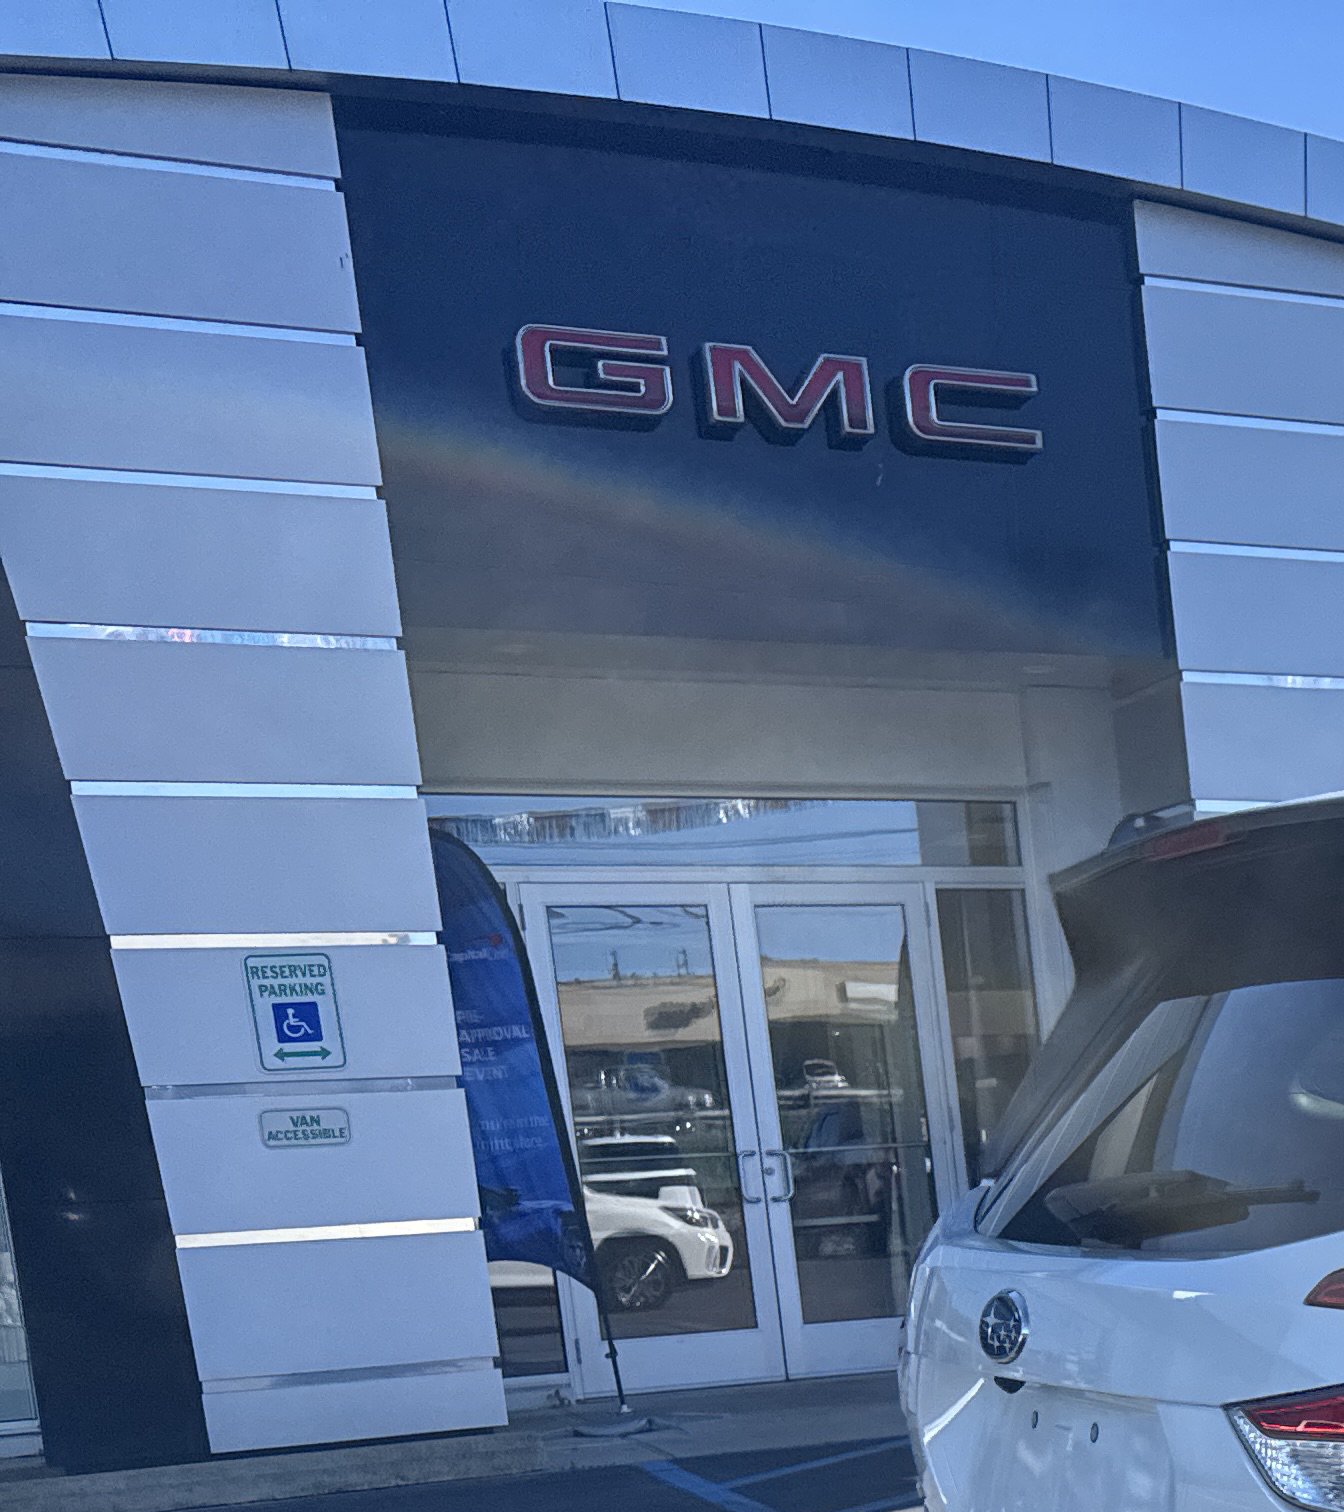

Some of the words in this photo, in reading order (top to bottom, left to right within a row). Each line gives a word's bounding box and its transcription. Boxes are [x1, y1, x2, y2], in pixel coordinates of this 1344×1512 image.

[515, 323, 1043, 451] GMC
[249, 963, 327, 980] RESERVED
[258, 981, 326, 998] PARKING
[460, 1046, 497, 1062] SALE
[289, 1114, 321, 1128] VAN
[267, 1127, 347, 1142] ACCESSIBLE
